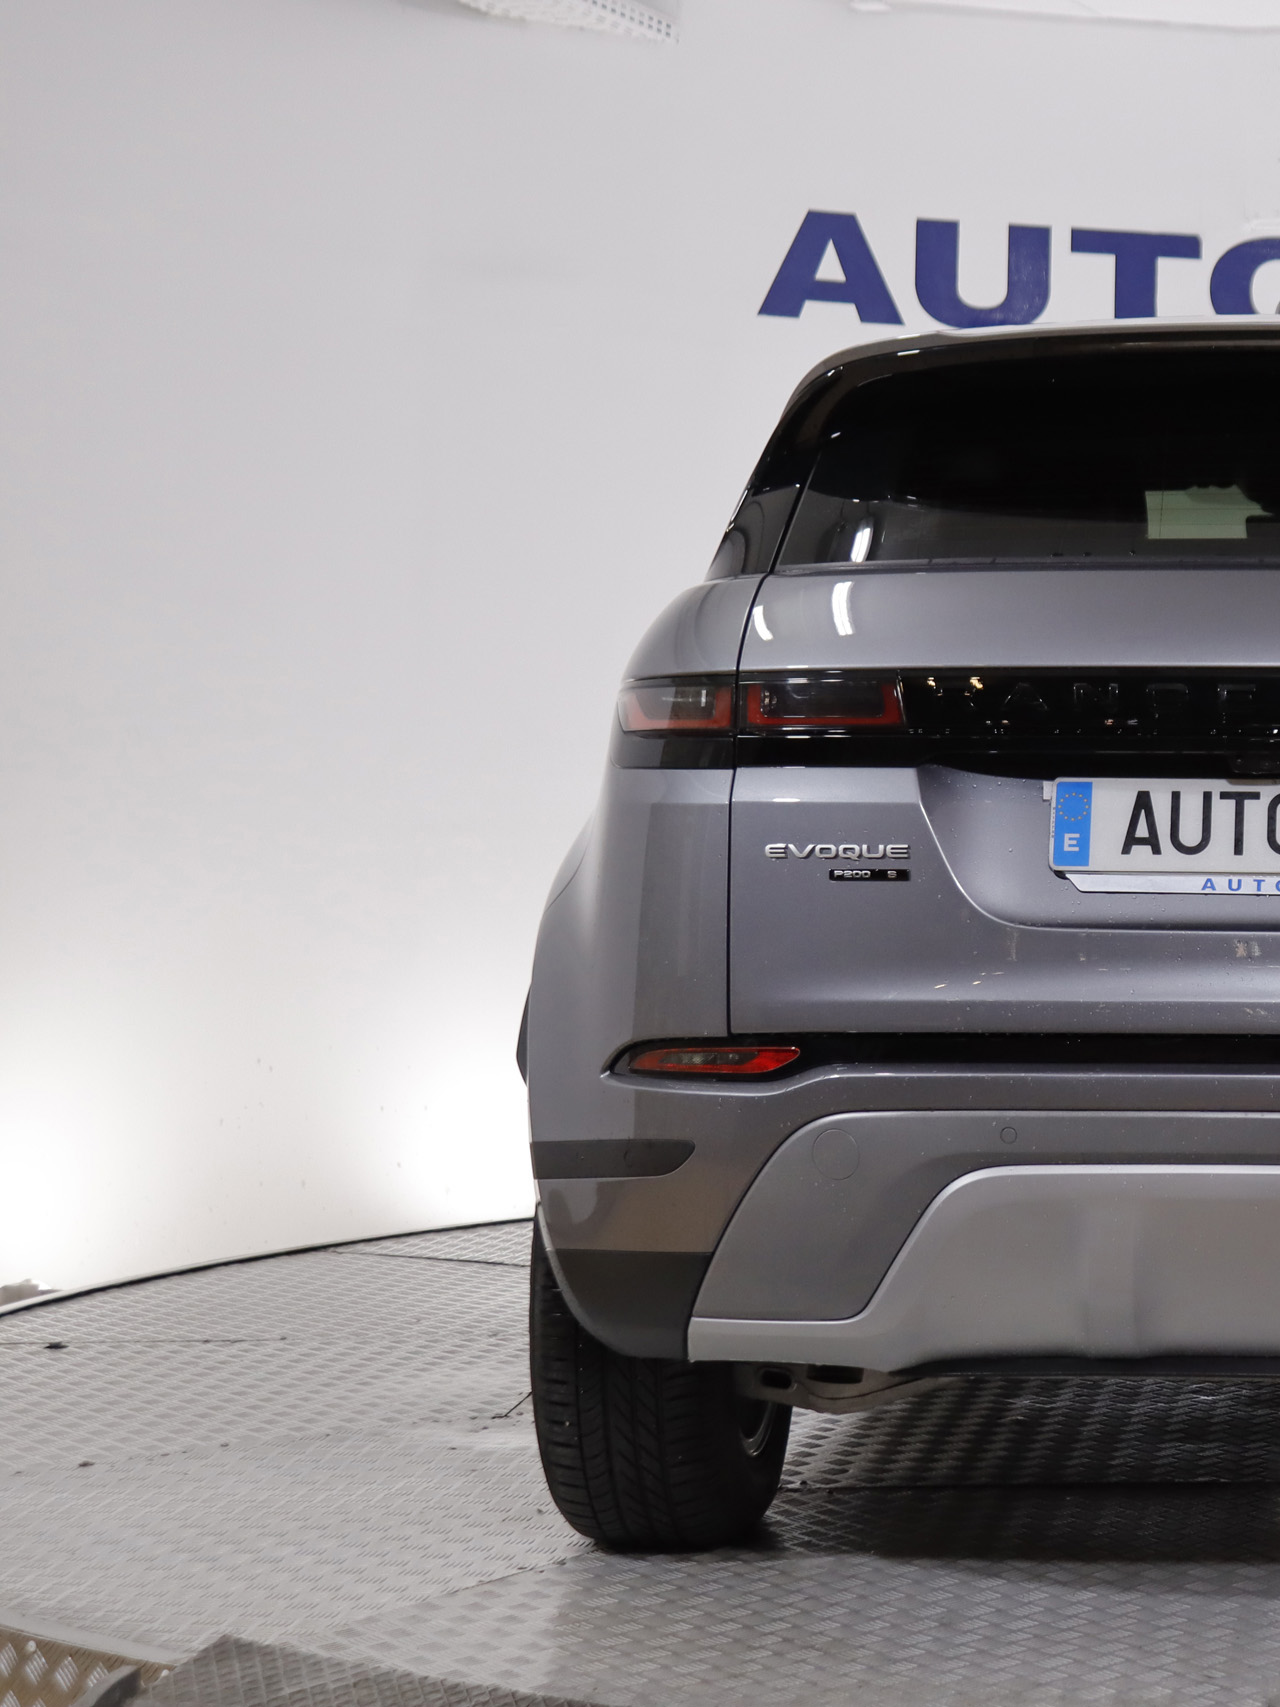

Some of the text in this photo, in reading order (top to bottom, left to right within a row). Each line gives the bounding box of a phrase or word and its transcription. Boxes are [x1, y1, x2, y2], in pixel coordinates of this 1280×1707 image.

[1064, 833, 1081, 852] E
[764, 843, 910, 861] EVOQUE
[833, 870, 898, 879] P200 S
